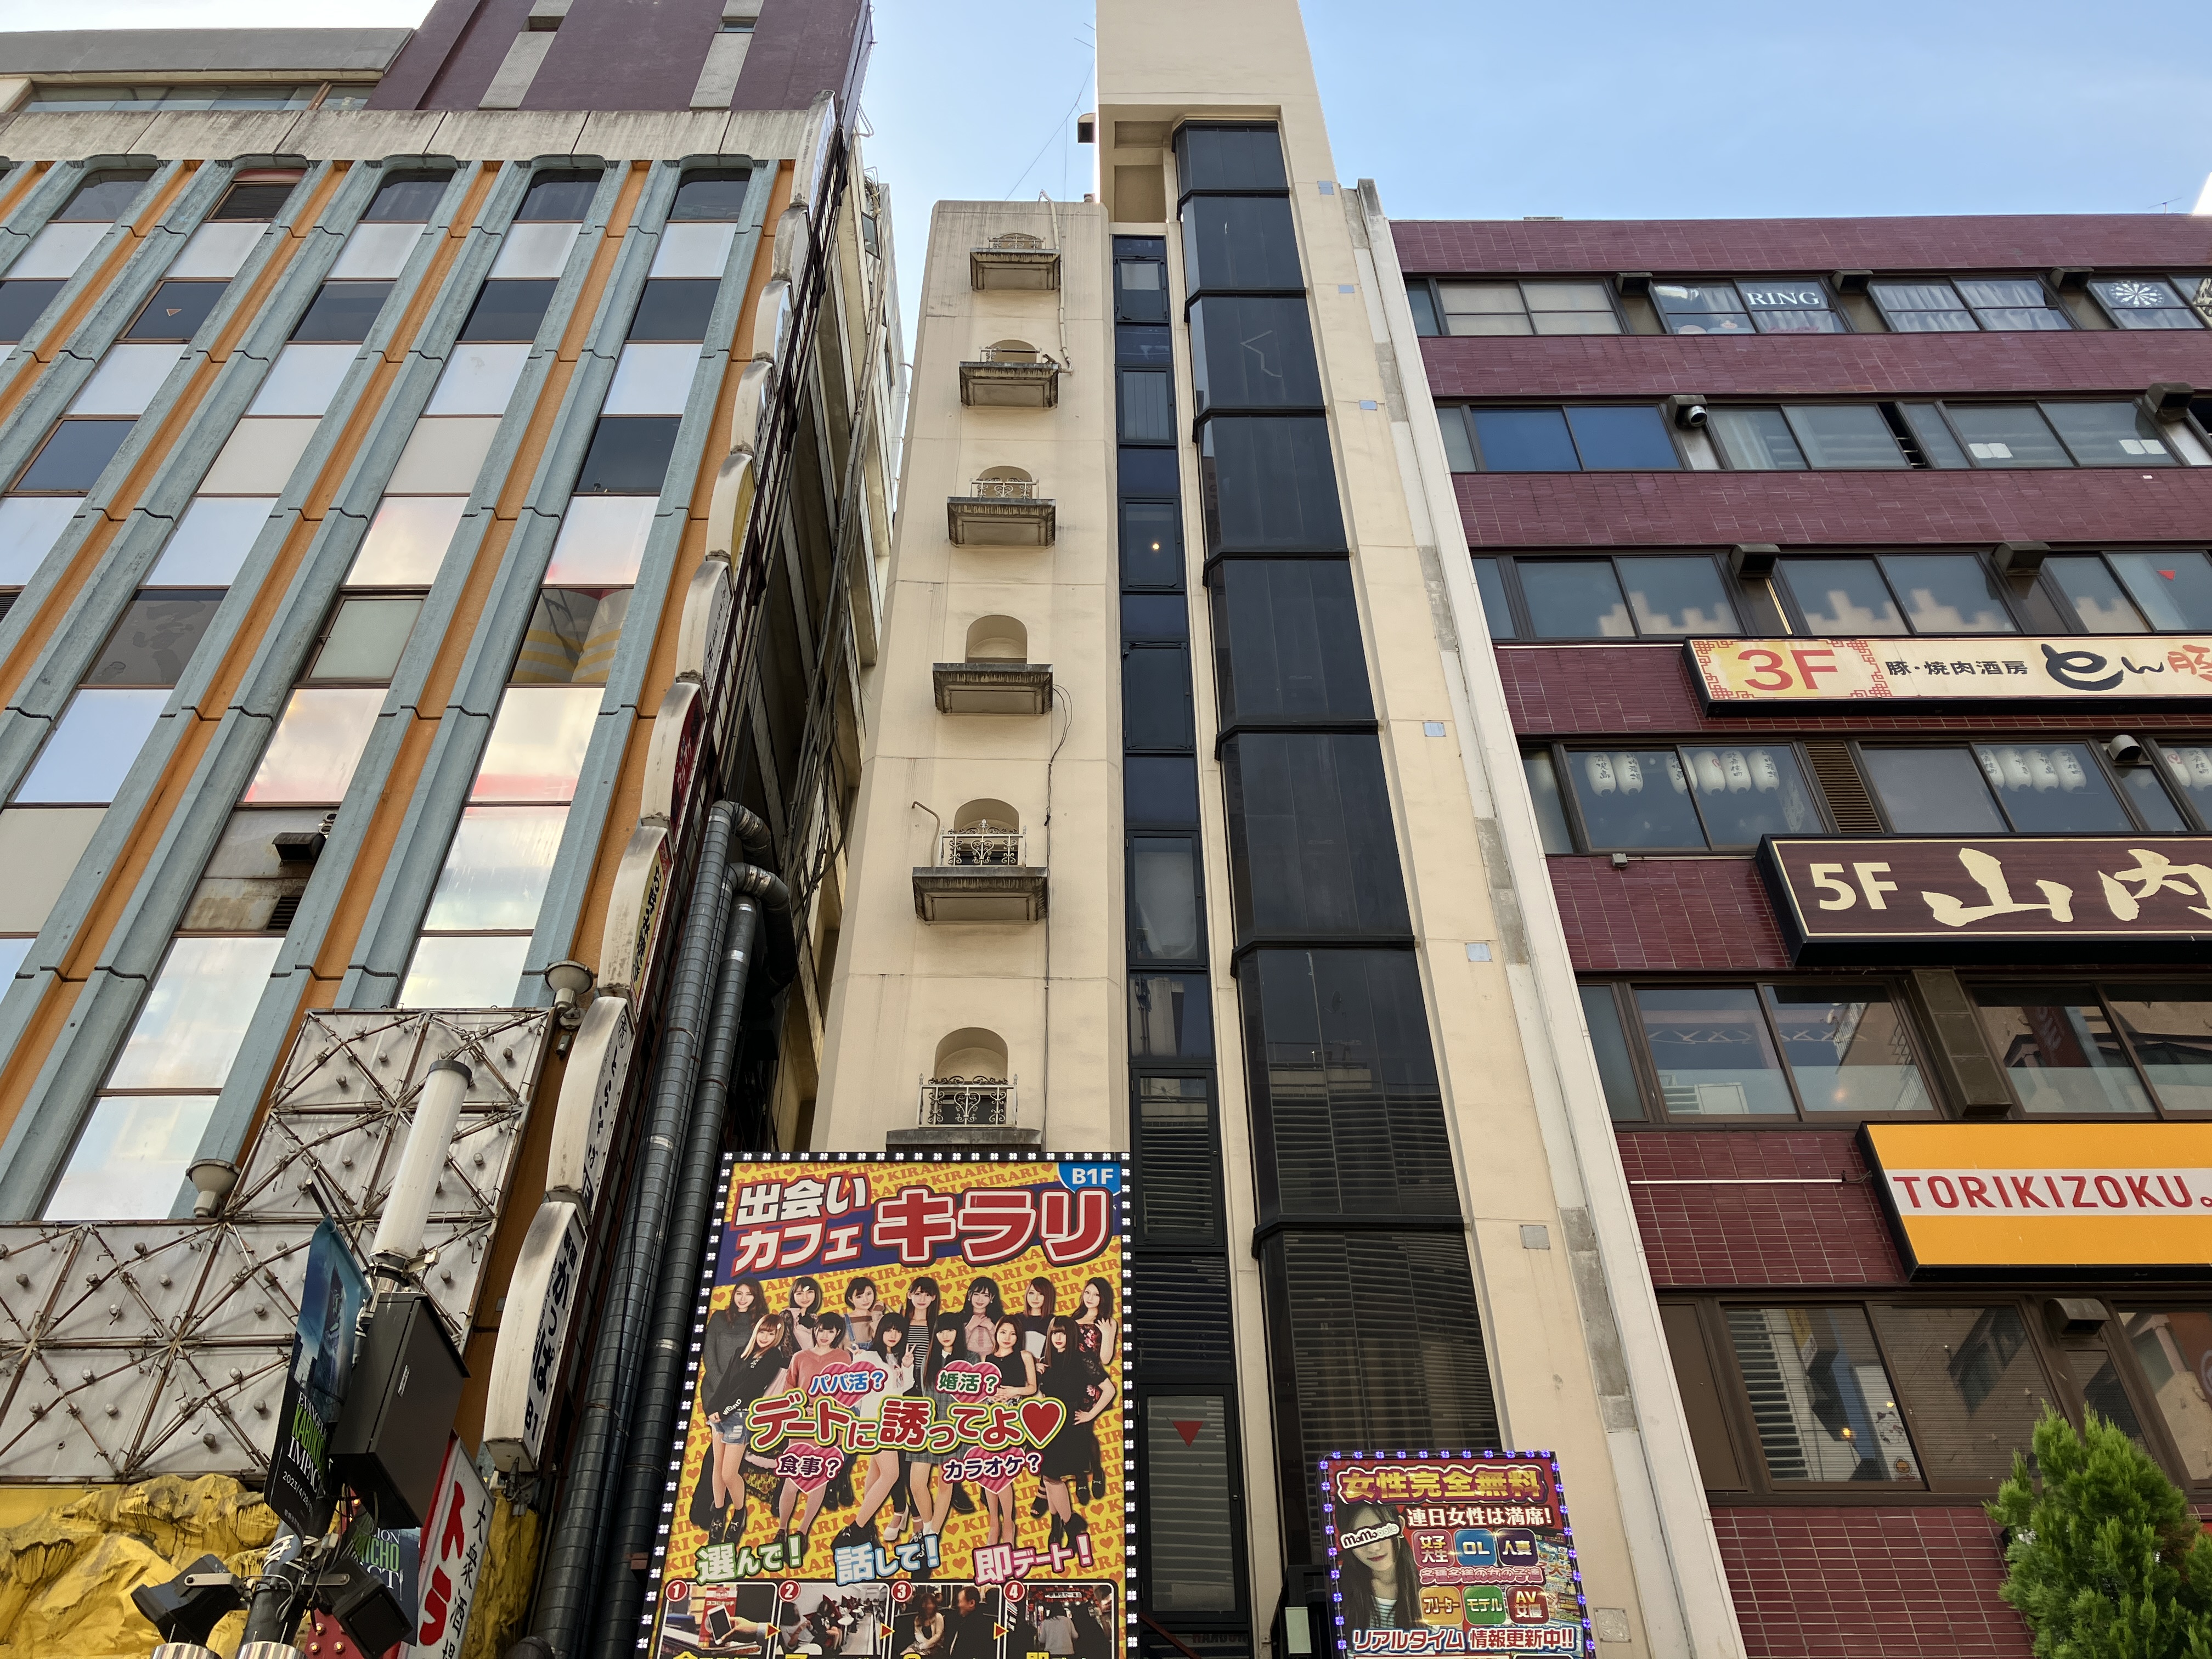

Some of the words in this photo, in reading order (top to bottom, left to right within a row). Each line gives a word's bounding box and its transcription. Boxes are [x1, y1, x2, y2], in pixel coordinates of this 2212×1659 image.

[1746, 292, 1820, 305] RING
[1737, 649, 1838, 692] 3F
[1809, 862, 1898, 910] 5F
[1072, 1168, 1114, 1184] B1F
[736, 1177, 866, 1226] 出会い
[873, 1189, 1107, 1262] キラリ
[735, 1223, 860, 1272] カフェ
[723, 1398, 742, 1415] WEIRD
[524, 1395, 539, 1442] B1
[1342, 1470, 1541, 1499] 女性完全無料
[1419, 1536, 1446, 1549] 女子
[1462, 1542, 1491, 1555] OL
[1502, 1540, 1532, 1555] 人妻
[1421, 1549, 1449, 1564] 大生
[1420, 1567, 1544, 1584] 多種多様の女の子達
[1467, 1598, 1503, 1612] モデル
[1516, 1590, 1537, 1603] AV
[1423, 1598, 1460, 1613] フリーター
[1353, 1629, 1463, 1652] リアルタイム
